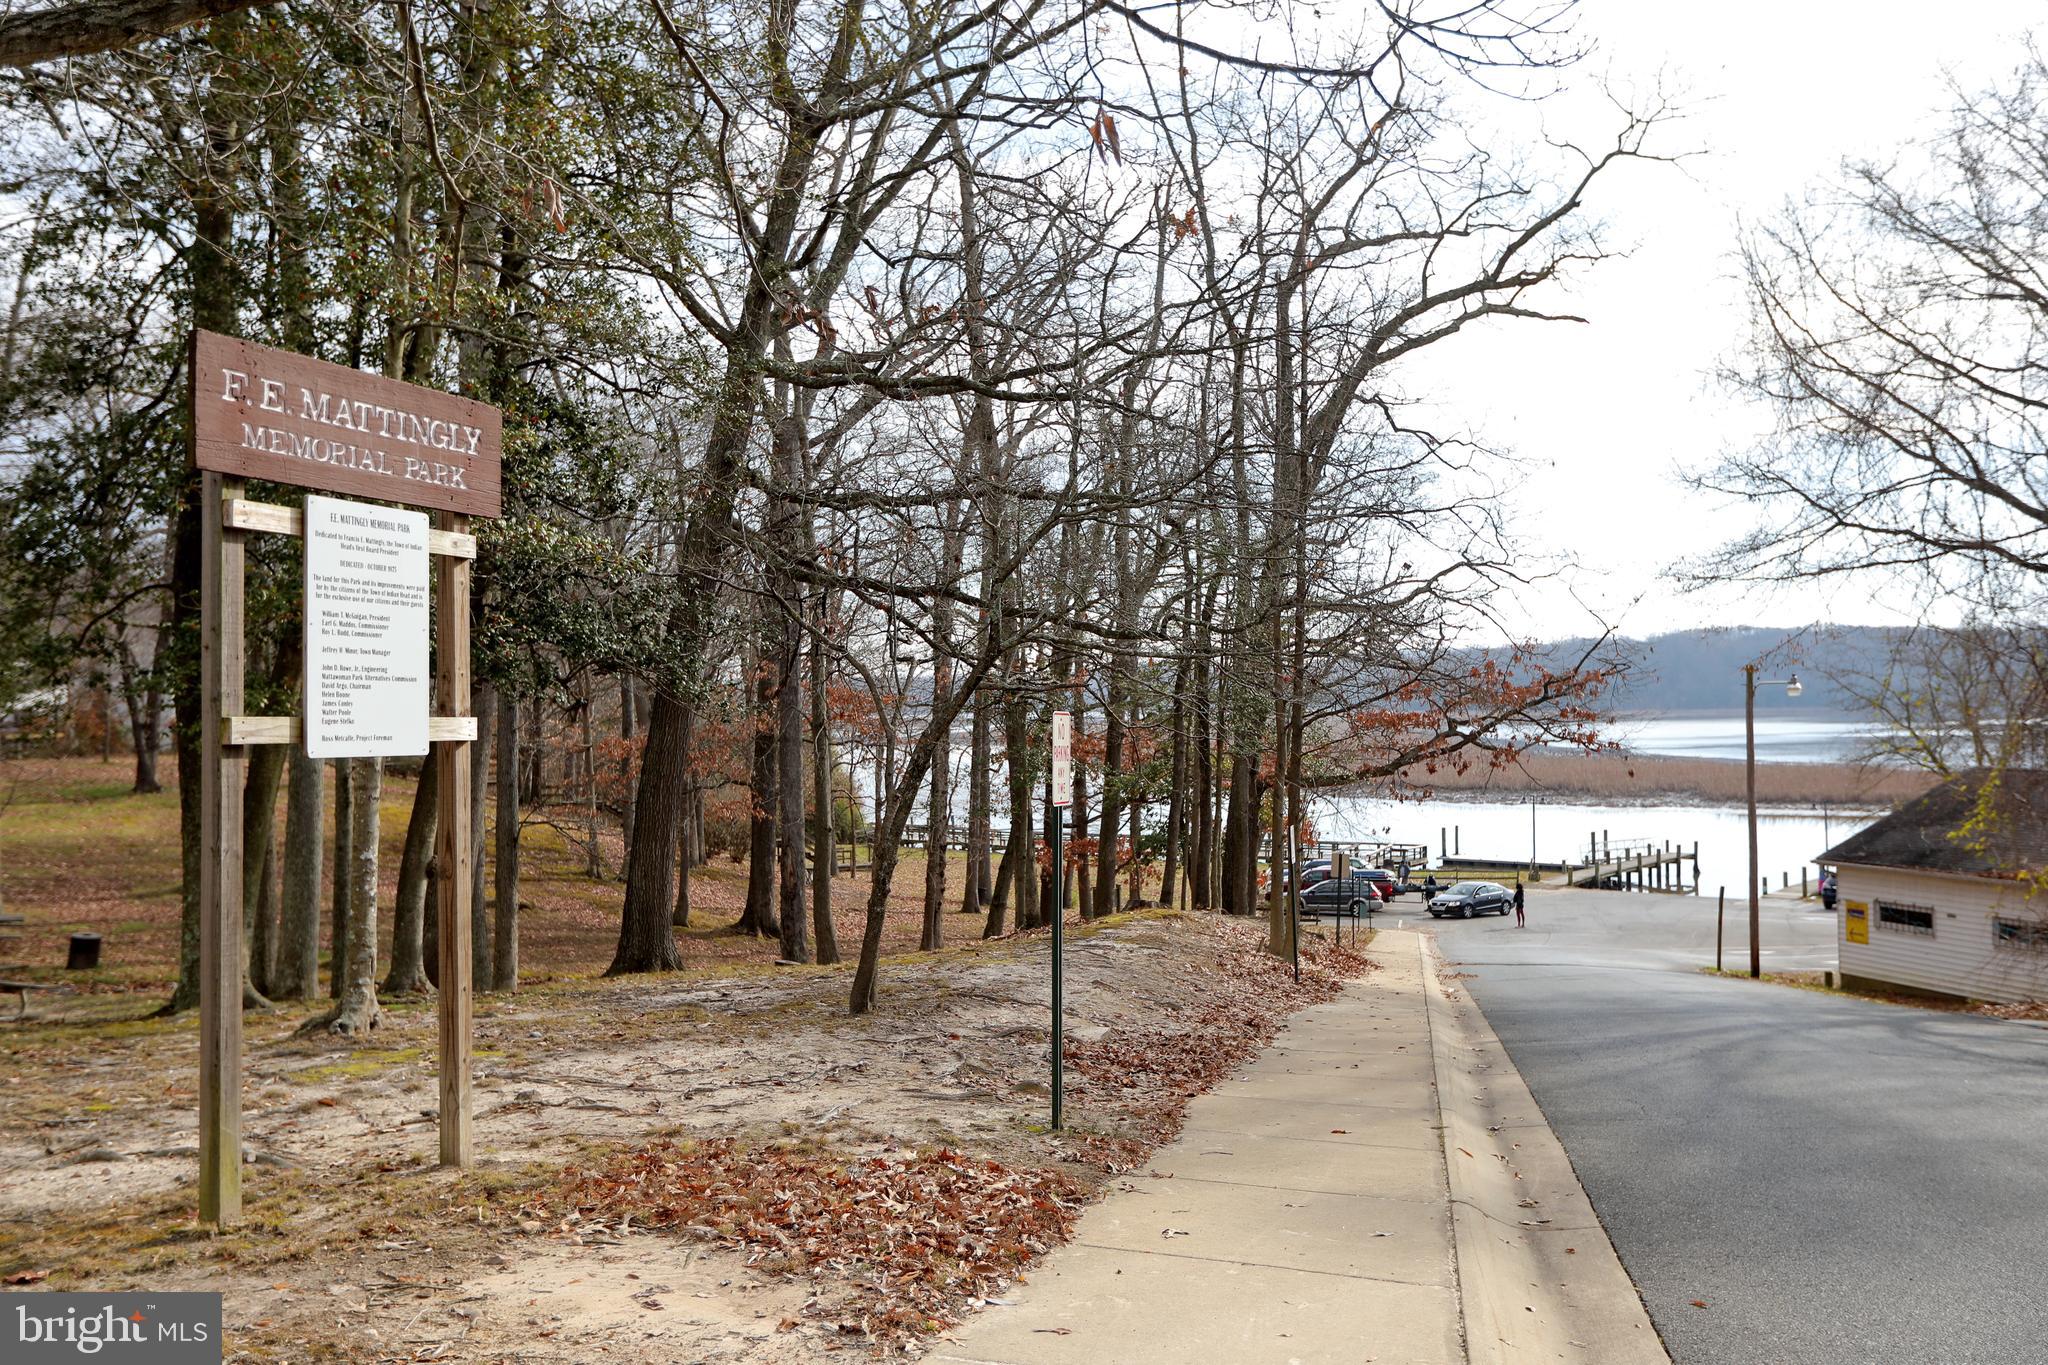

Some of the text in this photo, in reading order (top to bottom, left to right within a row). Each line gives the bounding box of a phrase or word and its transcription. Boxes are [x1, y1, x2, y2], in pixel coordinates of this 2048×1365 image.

[222, 368, 483, 456] F. E. MATTINGLY
[241, 422, 468, 490] MEMORIAL PARK
[340, 514, 368, 528] MATTINGLY
[370, 519, 396, 532] MEMORIAL
[398, 522, 411, 534] PARK
[314, 530, 337, 540] Dedicated
[380, 548, 400, 556] President
[369, 614, 391, 622] President
[372, 649, 392, 657] Manager
[362, 666, 388, 674] Engineering
[1058, 722, 1066, 740] NO
